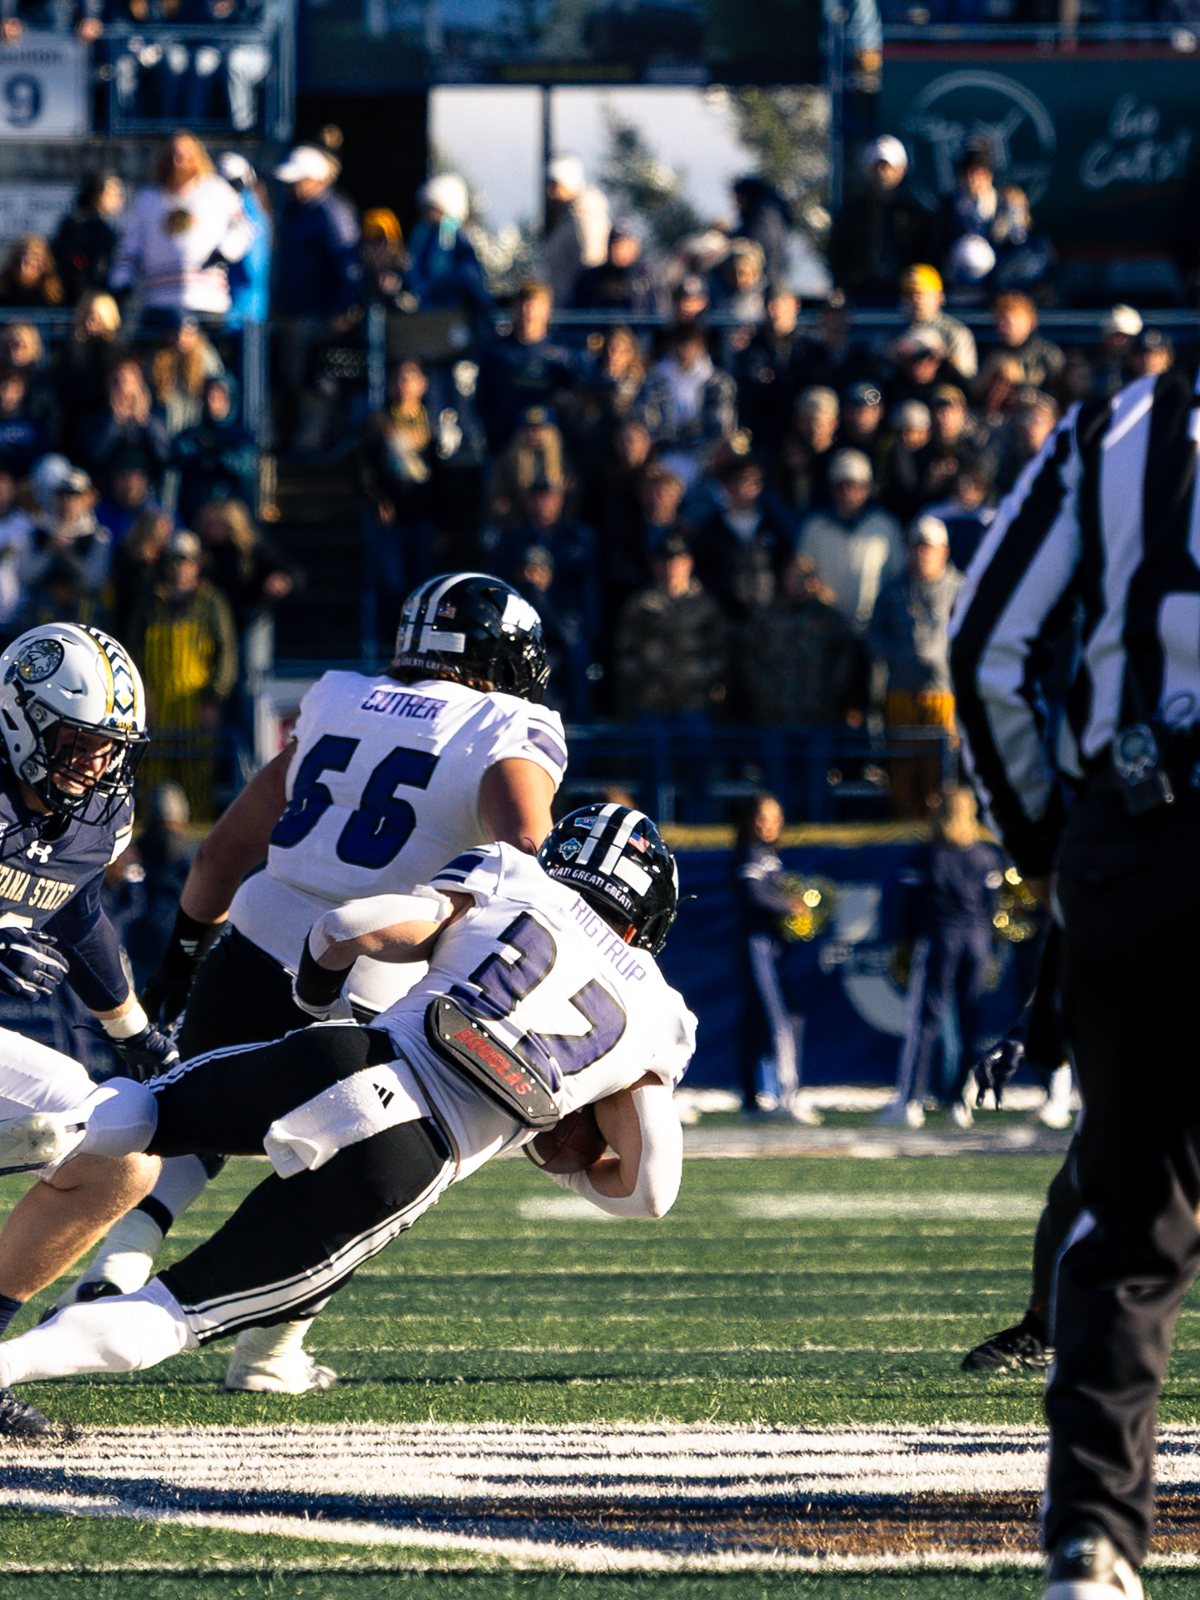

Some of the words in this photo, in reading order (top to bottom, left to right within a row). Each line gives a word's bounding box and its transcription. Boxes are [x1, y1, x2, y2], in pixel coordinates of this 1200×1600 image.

[28, 877, 76, 910] STATE
[572, 869, 605, 888] GREAT!
[603, 882, 632, 911] GREAT!
[569, 898, 647, 981] RIGTRUP
[454, 1028, 533, 1096] DOUGLAS
